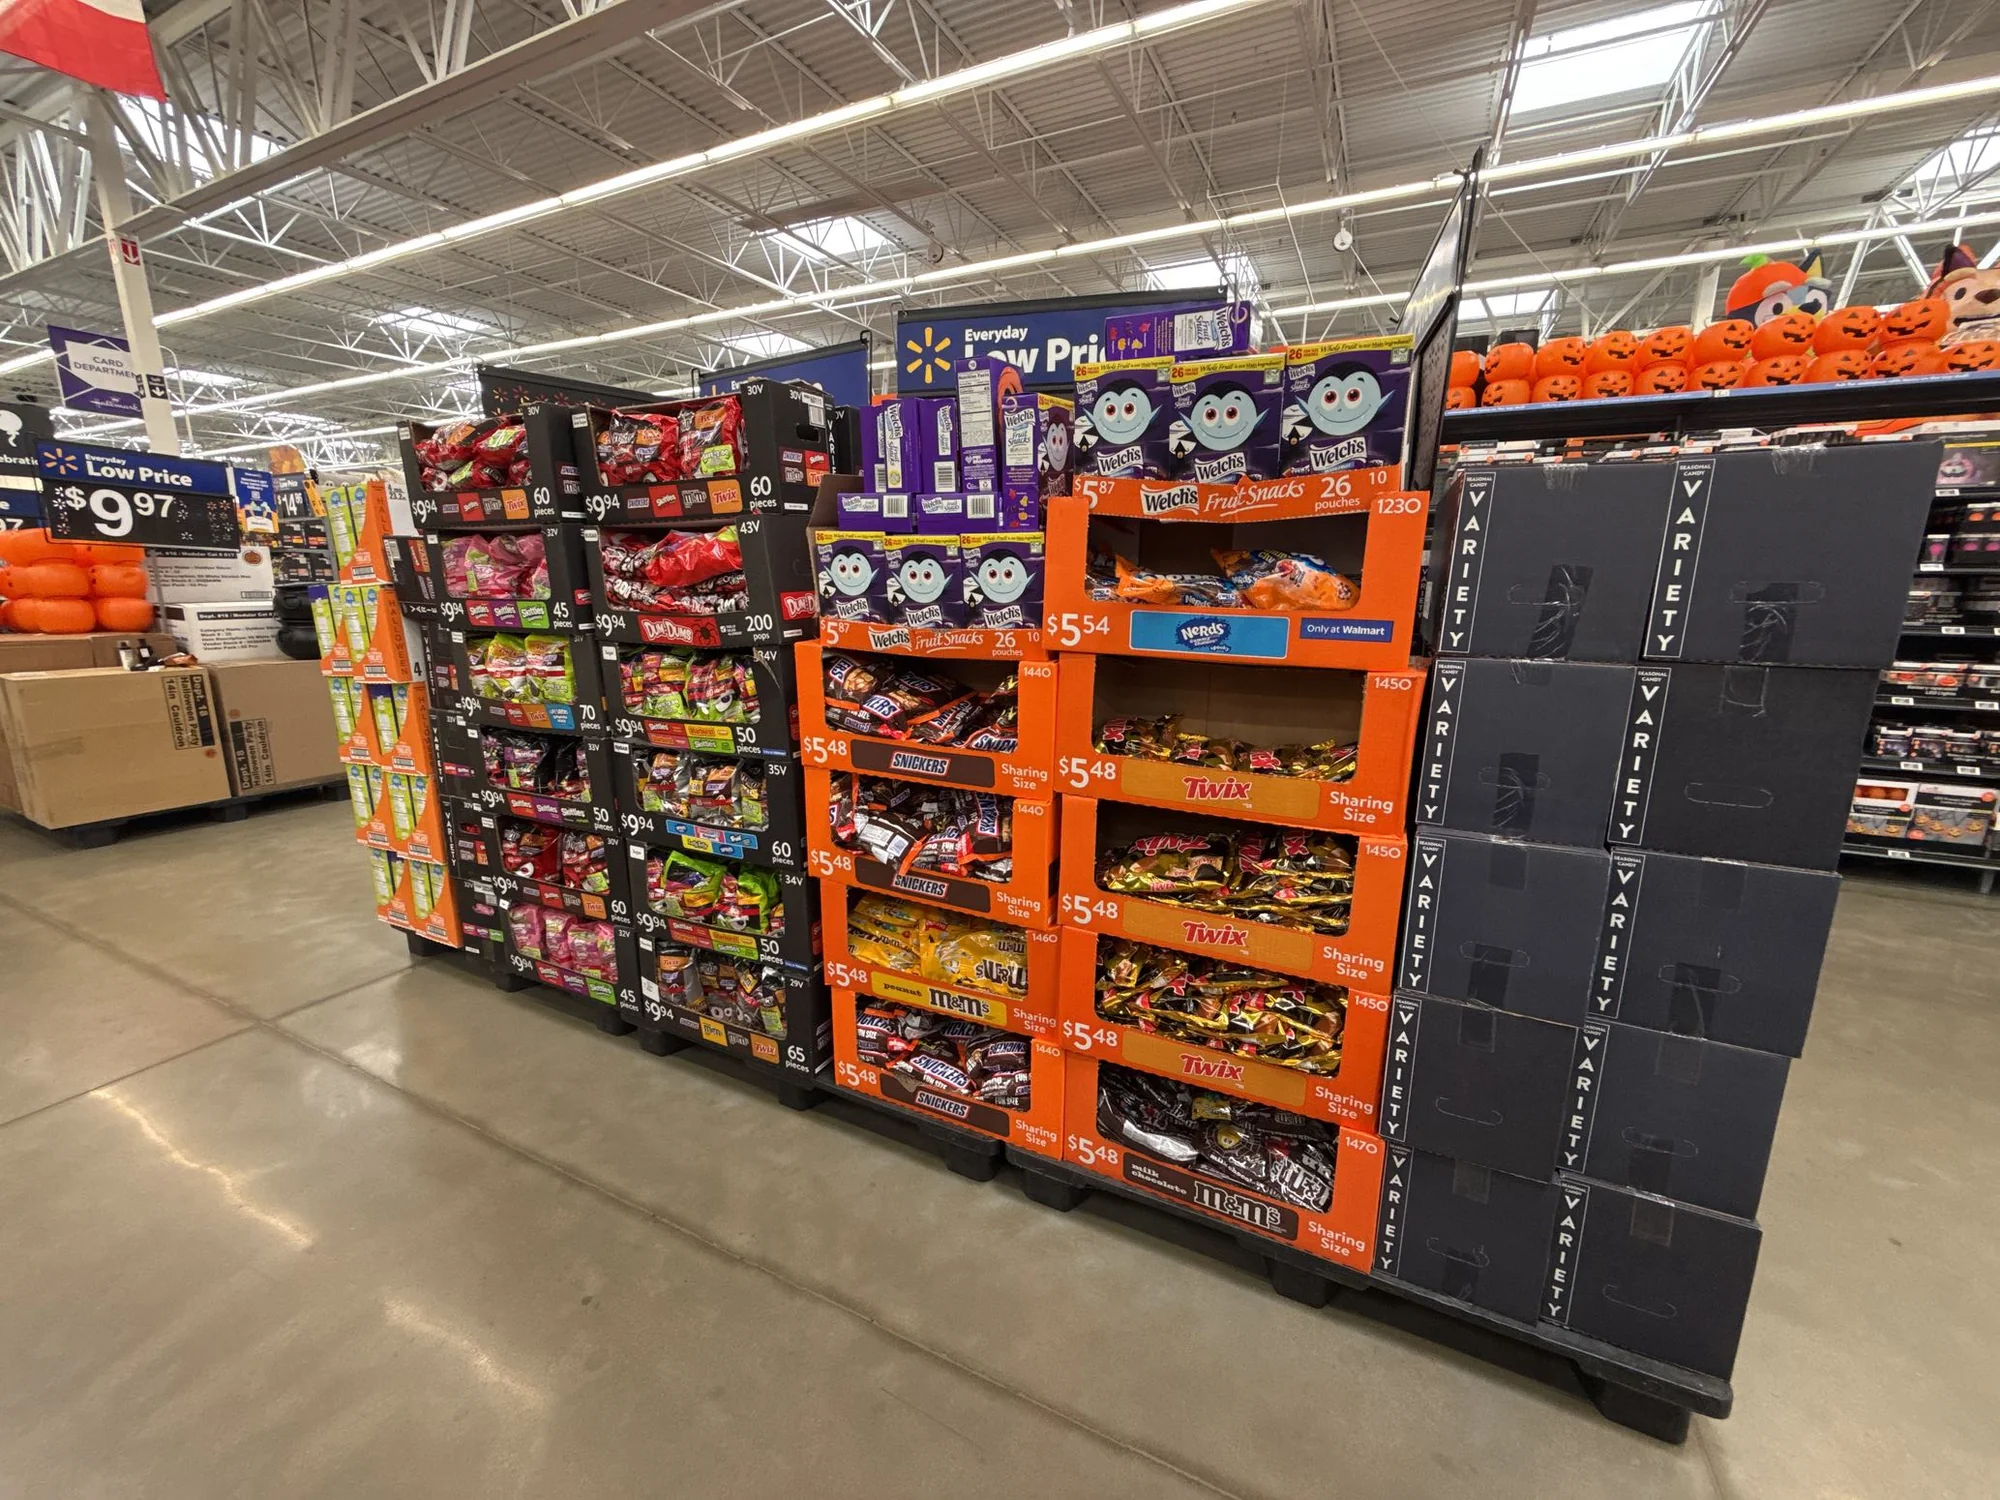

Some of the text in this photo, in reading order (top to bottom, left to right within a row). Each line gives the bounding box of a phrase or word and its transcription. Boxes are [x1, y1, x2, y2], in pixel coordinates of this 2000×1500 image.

[964, 325, 1029, 343] Everyday
[1215, 306, 1232, 348] Welch's
[93, 356, 124, 367] CARD
[1047, 334, 1106, 373] Pri
[1288, 349, 1302, 360] 26
[74, 362, 137, 378] DEPARTMEN
[1075, 366, 1087, 376] 26
[1172, 367, 1184, 378] 26
[747, 384, 764, 396] 30V
[888, 403, 903, 437] Welch's
[1006, 410, 1034, 427] Welch's
[85, 453, 126, 466] Everyday
[1099, 448, 1142, 474] Welch's
[1311, 440, 1365, 467] Welch's
[86, 462, 193, 487] Low Price
[1196, 455, 1245, 482] Welch's
[750, 476, 772, 495] 60
[1320, 474, 1352, 498] 26
[1368, 471, 1388, 486] 10
[534, 487, 550, 505] 60
[750, 498, 777, 510] pieces
[1144, 480, 1305, 513] Welch's Fruit Snacks
[1314, 496, 1360, 511] pouches
[534, 506, 555, 517] pieces
[1377, 497, 1421, 515] 1230
[740, 520, 761, 534] 43V
[1449, 490, 1487, 648] VARIETY
[1656, 478, 1704, 652] VARIETY
[553, 602, 570, 618] 45
[838, 600, 868, 618] Welch's
[907, 607, 941, 625] Welch's
[986, 607, 1022, 627] Welch's
[553, 619, 573, 629] pieces
[745, 614, 773, 633] 200
[1307, 625, 1385, 636] Only at Walmart
[753, 630, 770, 642] pops
[870, 631, 984, 649] Welch's Fruit Snacks
[994, 631, 1016, 648] 26
[1027, 632, 1040, 642] 10
[992, 648, 1024, 657] pouches
[424, 637, 436, 696] VARIETY
[1023, 666, 1052, 678] 1440
[1374, 677, 1412, 691] 1450
[180, 677, 195, 722] Halloween
[579, 705, 596, 720] 70
[171, 705, 185, 747] Cauldron
[580, 722, 601, 731] pieces
[736, 726, 756, 744] 50
[257, 721, 270, 760] Cauldron
[736, 744, 761, 754] pieces
[1424, 676, 1458, 819] VARIETY
[432, 727, 444, 784] VARIETY
[892, 752, 949, 774] SNICKERS
[1618, 684, 1661, 839] VARIETY
[768, 764, 787, 776] 35V
[1001, 763, 1049, 781] Sharing
[1012, 776, 1037, 790] Size
[1181, 776, 1252, 800] Twix
[1017, 804, 1044, 816] 1440
[1329, 791, 1394, 813] Sharing
[593, 807, 609, 822] 50
[1343, 808, 1376, 824] Size
[594, 822, 614, 832] pieces
[445, 812, 457, 867] VARIETY
[772, 841, 791, 857] 60
[1365, 845, 1401, 859] 1450
[772, 856, 794, 866] pieces
[785, 875, 803, 886] 34V
[894, 875, 946, 896] SNICKERS
[611, 900, 627, 915] 60
[996, 892, 1041, 910] Sharing
[610, 914, 631, 925] pieces
[1007, 905, 1031, 919] Size
[1409, 853, 1438, 988] VARIETY
[1031, 932, 1058, 943] 1460
[1181, 921, 1248, 946] Twix
[1596, 869, 1635, 1012] VARIETY
[760, 938, 779, 955] 50
[760, 954, 784, 965] pieces
[1322, 946, 1385, 972] Sharing
[1336, 963, 1368, 980] Size
[620, 988, 636, 1004] 45
[883, 982, 923, 998] peanut
[619, 1002, 639, 1012] pieces
[1354, 995, 1389, 1012] 1450
[1013, 1008, 1057, 1027] Sharing
[1024, 1021, 1047, 1034] Size
[787, 1045, 806, 1063] 65
[1035, 1046, 1061, 1057] 1440
[785, 1060, 810, 1073] pieces
[914, 1055, 970, 1087] SNICKERS
[1180, 1054, 1245, 1081] Twix
[1386, 1011, 1412, 1136] VARIETY
[917, 1092, 968, 1117] SNICKERS
[1315, 1085, 1374, 1114] Sharing
[1564, 1036, 1600, 1167] VARIETY
[1328, 1102, 1358, 1120] Size
[1015, 1120, 1057, 1142] Sharing
[1025, 1133, 1047, 1148] Size
[1345, 1136, 1378, 1155] 1470
[1132, 1163, 1160, 1178] milk
[1131, 1170, 1188, 1195] chocolate
[1380, 1155, 1406, 1270] VARIETY
[1308, 1220, 1367, 1252] Sharing
[1320, 1238, 1350, 1256] Size
[1547, 1195, 1581, 1318] VARIETY
